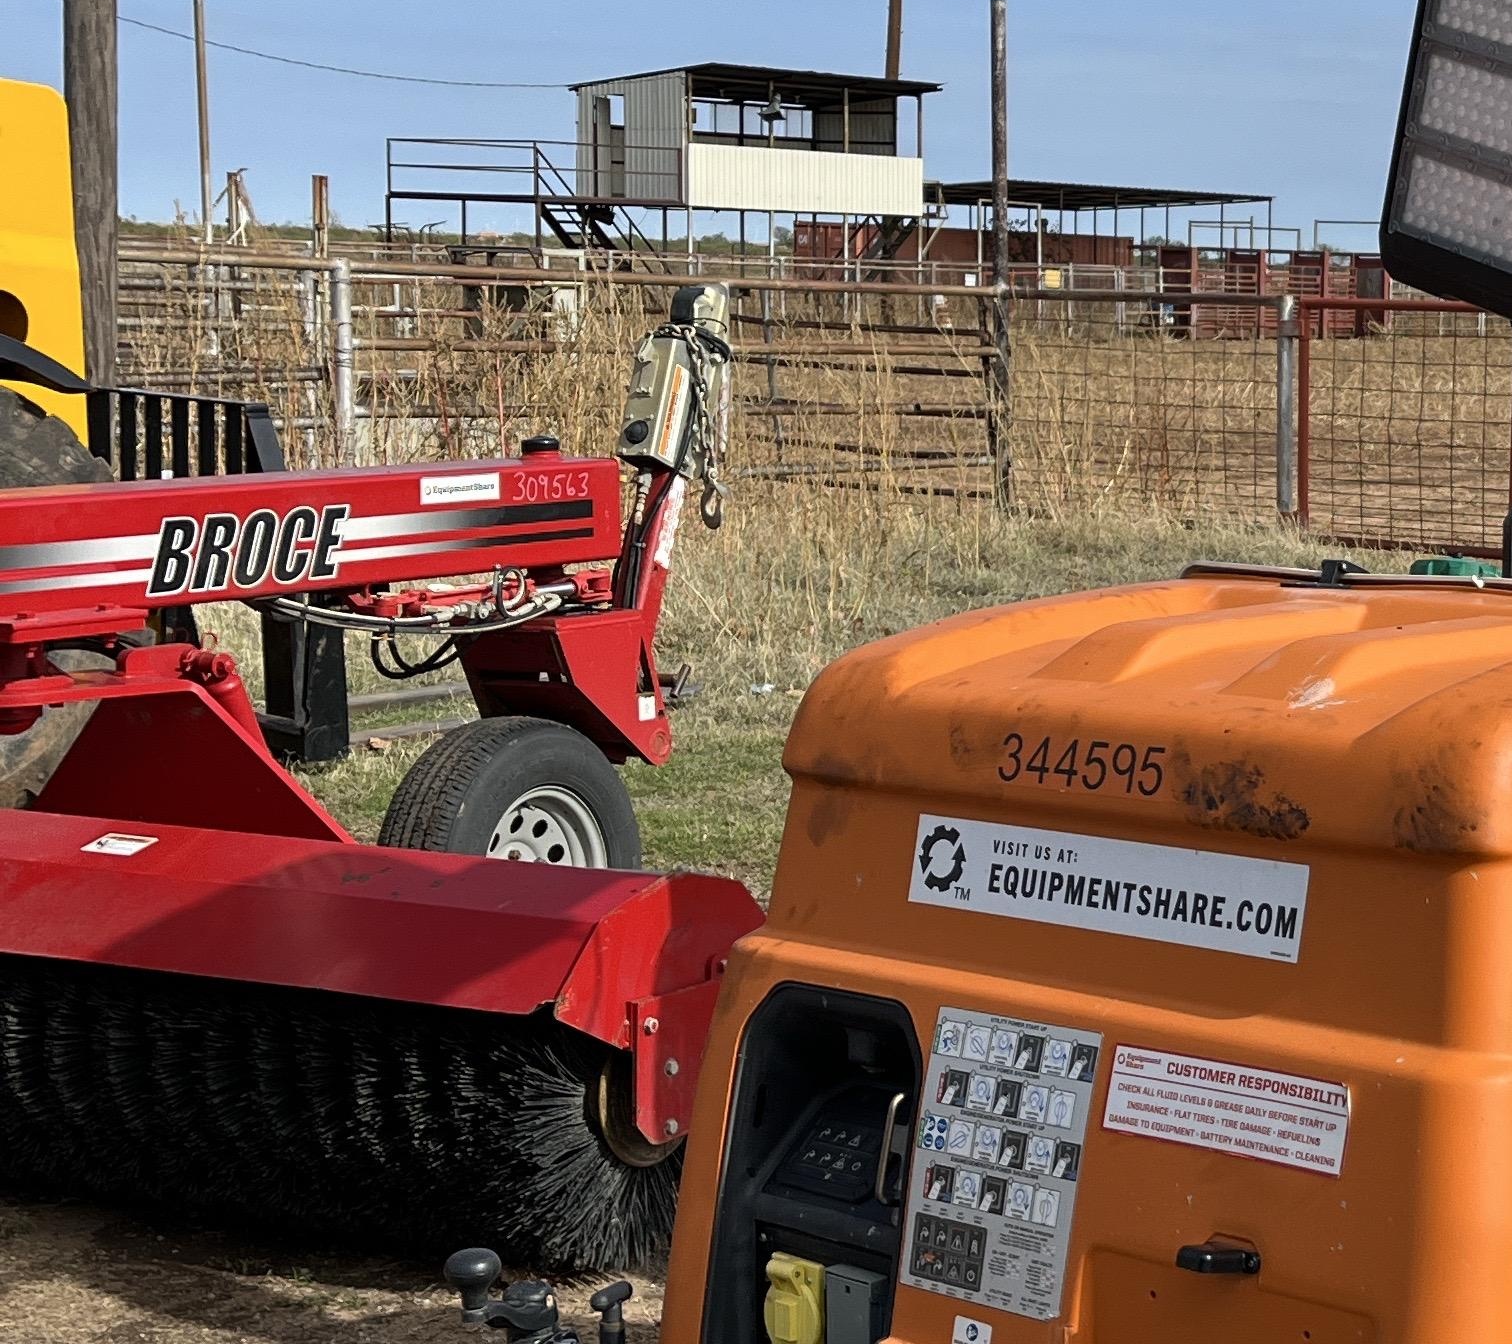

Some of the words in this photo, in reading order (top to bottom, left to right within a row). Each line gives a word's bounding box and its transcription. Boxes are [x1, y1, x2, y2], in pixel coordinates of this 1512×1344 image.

[432, 482, 495, 494] EquipmentShare
[512, 471, 589, 502] 309563
[147, 505, 349, 596] BROCE
[998, 733, 1166, 796] 344595
[993, 839, 1028, 857] VISIT
[1035, 845, 1051, 861] US
[1057, 848, 1078, 864] AT:
[953, 886, 971, 901] TM
[988, 863, 1298, 940] EQUIPMENTSHARE.COM
[1118, 1082, 1142, 1094] CHECK
[1142, 1087, 1155, 1097] ALL
[1156, 1089, 1178, 1101] FLUID
[1180, 1093, 1206, 1106] LEVELS
[1214, 1099, 1244, 1113] GREASE
[1245, 1105, 1267, 1118] DAILY
[1268, 1110, 1298, 1125] BEFORE
[1299, 1116, 1325, 1130] START
[1325, 1121, 1337, 1131] UP
[1166, 1061, 1236, 1085] CUSTOMER
[1238, 1074, 1347, 1108] RESPONSIBILITY
[1109, 1113, 1139, 1127] DAMAGE
[1141, 1119, 1150, 1129] TO
[1151, 1121, 1195, 1137] EQUIPMENT
[1200, 1131, 1232, 1145] BATTERY
[1234, 1137, 1289, 1157] MAINTENANCE
[1295, 1151, 1335, 1167] CLEANING
[1126, 1100, 1169, 1116] INSURANCE
[1174, 1109, 1191, 1120] FLAT
[1193, 1112, 1215, 1125] TIRES
[1221, 1118, 1238, 1130] TIRE
[1239, 1122, 1271, 1136] DAMAGE
[1277, 1129, 1321, 1146] REFUELING
